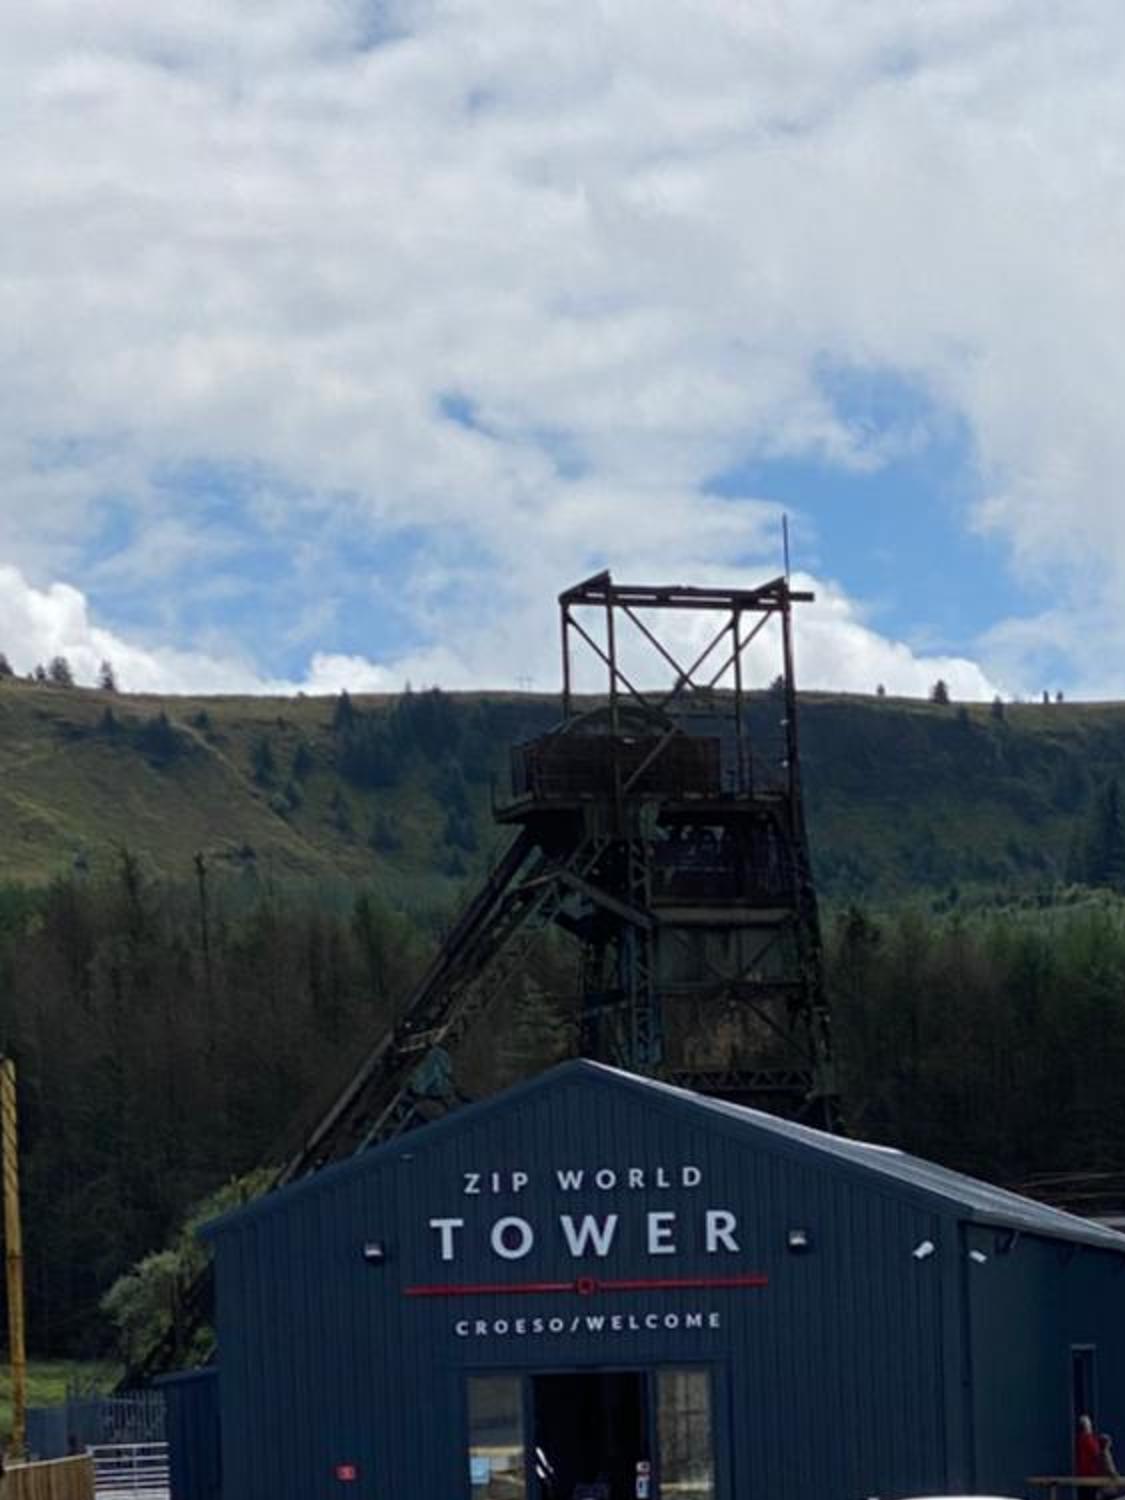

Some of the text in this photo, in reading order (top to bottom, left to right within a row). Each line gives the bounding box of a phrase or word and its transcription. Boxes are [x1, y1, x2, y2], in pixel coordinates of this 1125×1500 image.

[464, 1166, 702, 1194] ZIP WORLD
[429, 1210, 740, 1261] TOWER
[455, 1312, 720, 1336] CROESO/WELCOME
